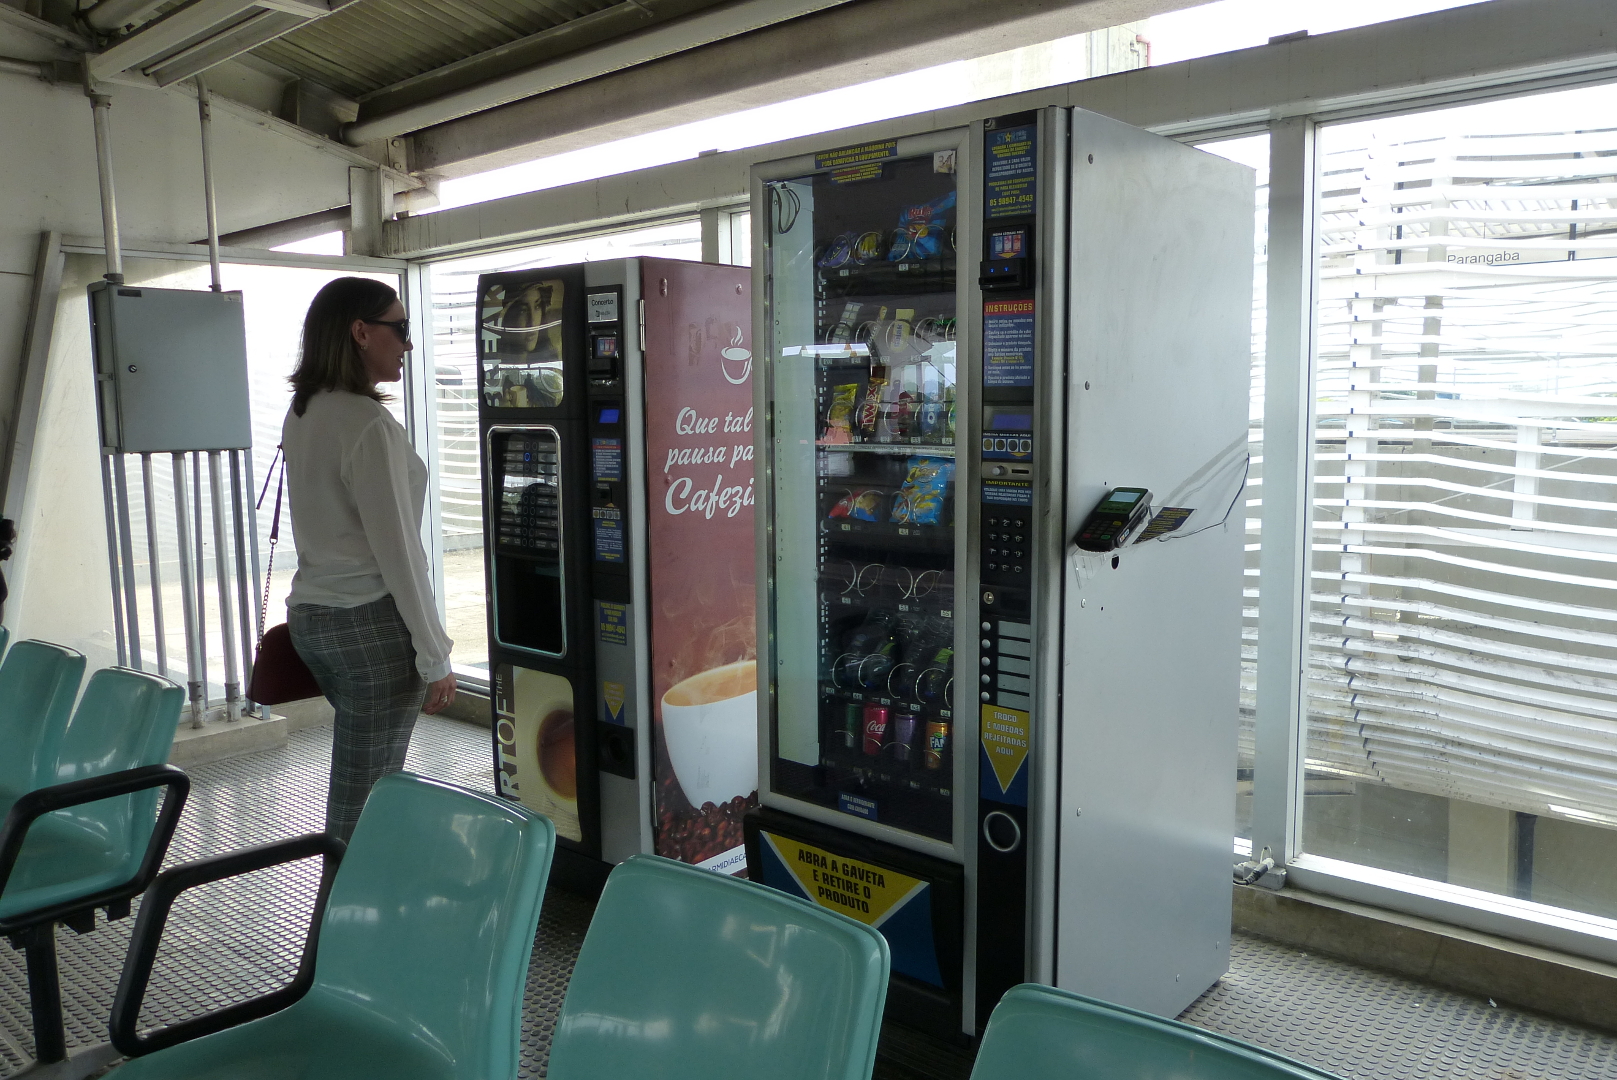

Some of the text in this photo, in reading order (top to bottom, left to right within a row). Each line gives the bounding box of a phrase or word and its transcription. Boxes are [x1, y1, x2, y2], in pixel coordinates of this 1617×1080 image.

[1448, 251, 1520, 265] Parangaba
[986, 302, 1032, 313] INSTRUÇÕES
[862, 386, 877, 425] TWIX
[676, 406, 753, 435] Que tal
[664, 446, 726, 474] pausa
[994, 711, 1017, 723] TROCO
[984, 732, 1026, 748] REJEITADAS
[993, 723, 1024, 736] MOEDAS
[996, 746, 1014, 756] AQUI
[798, 848, 886, 889] ABRA A GAVETA
[813, 869, 871, 900] E RETIRE O
[818, 886, 870, 914] PRODUTO
